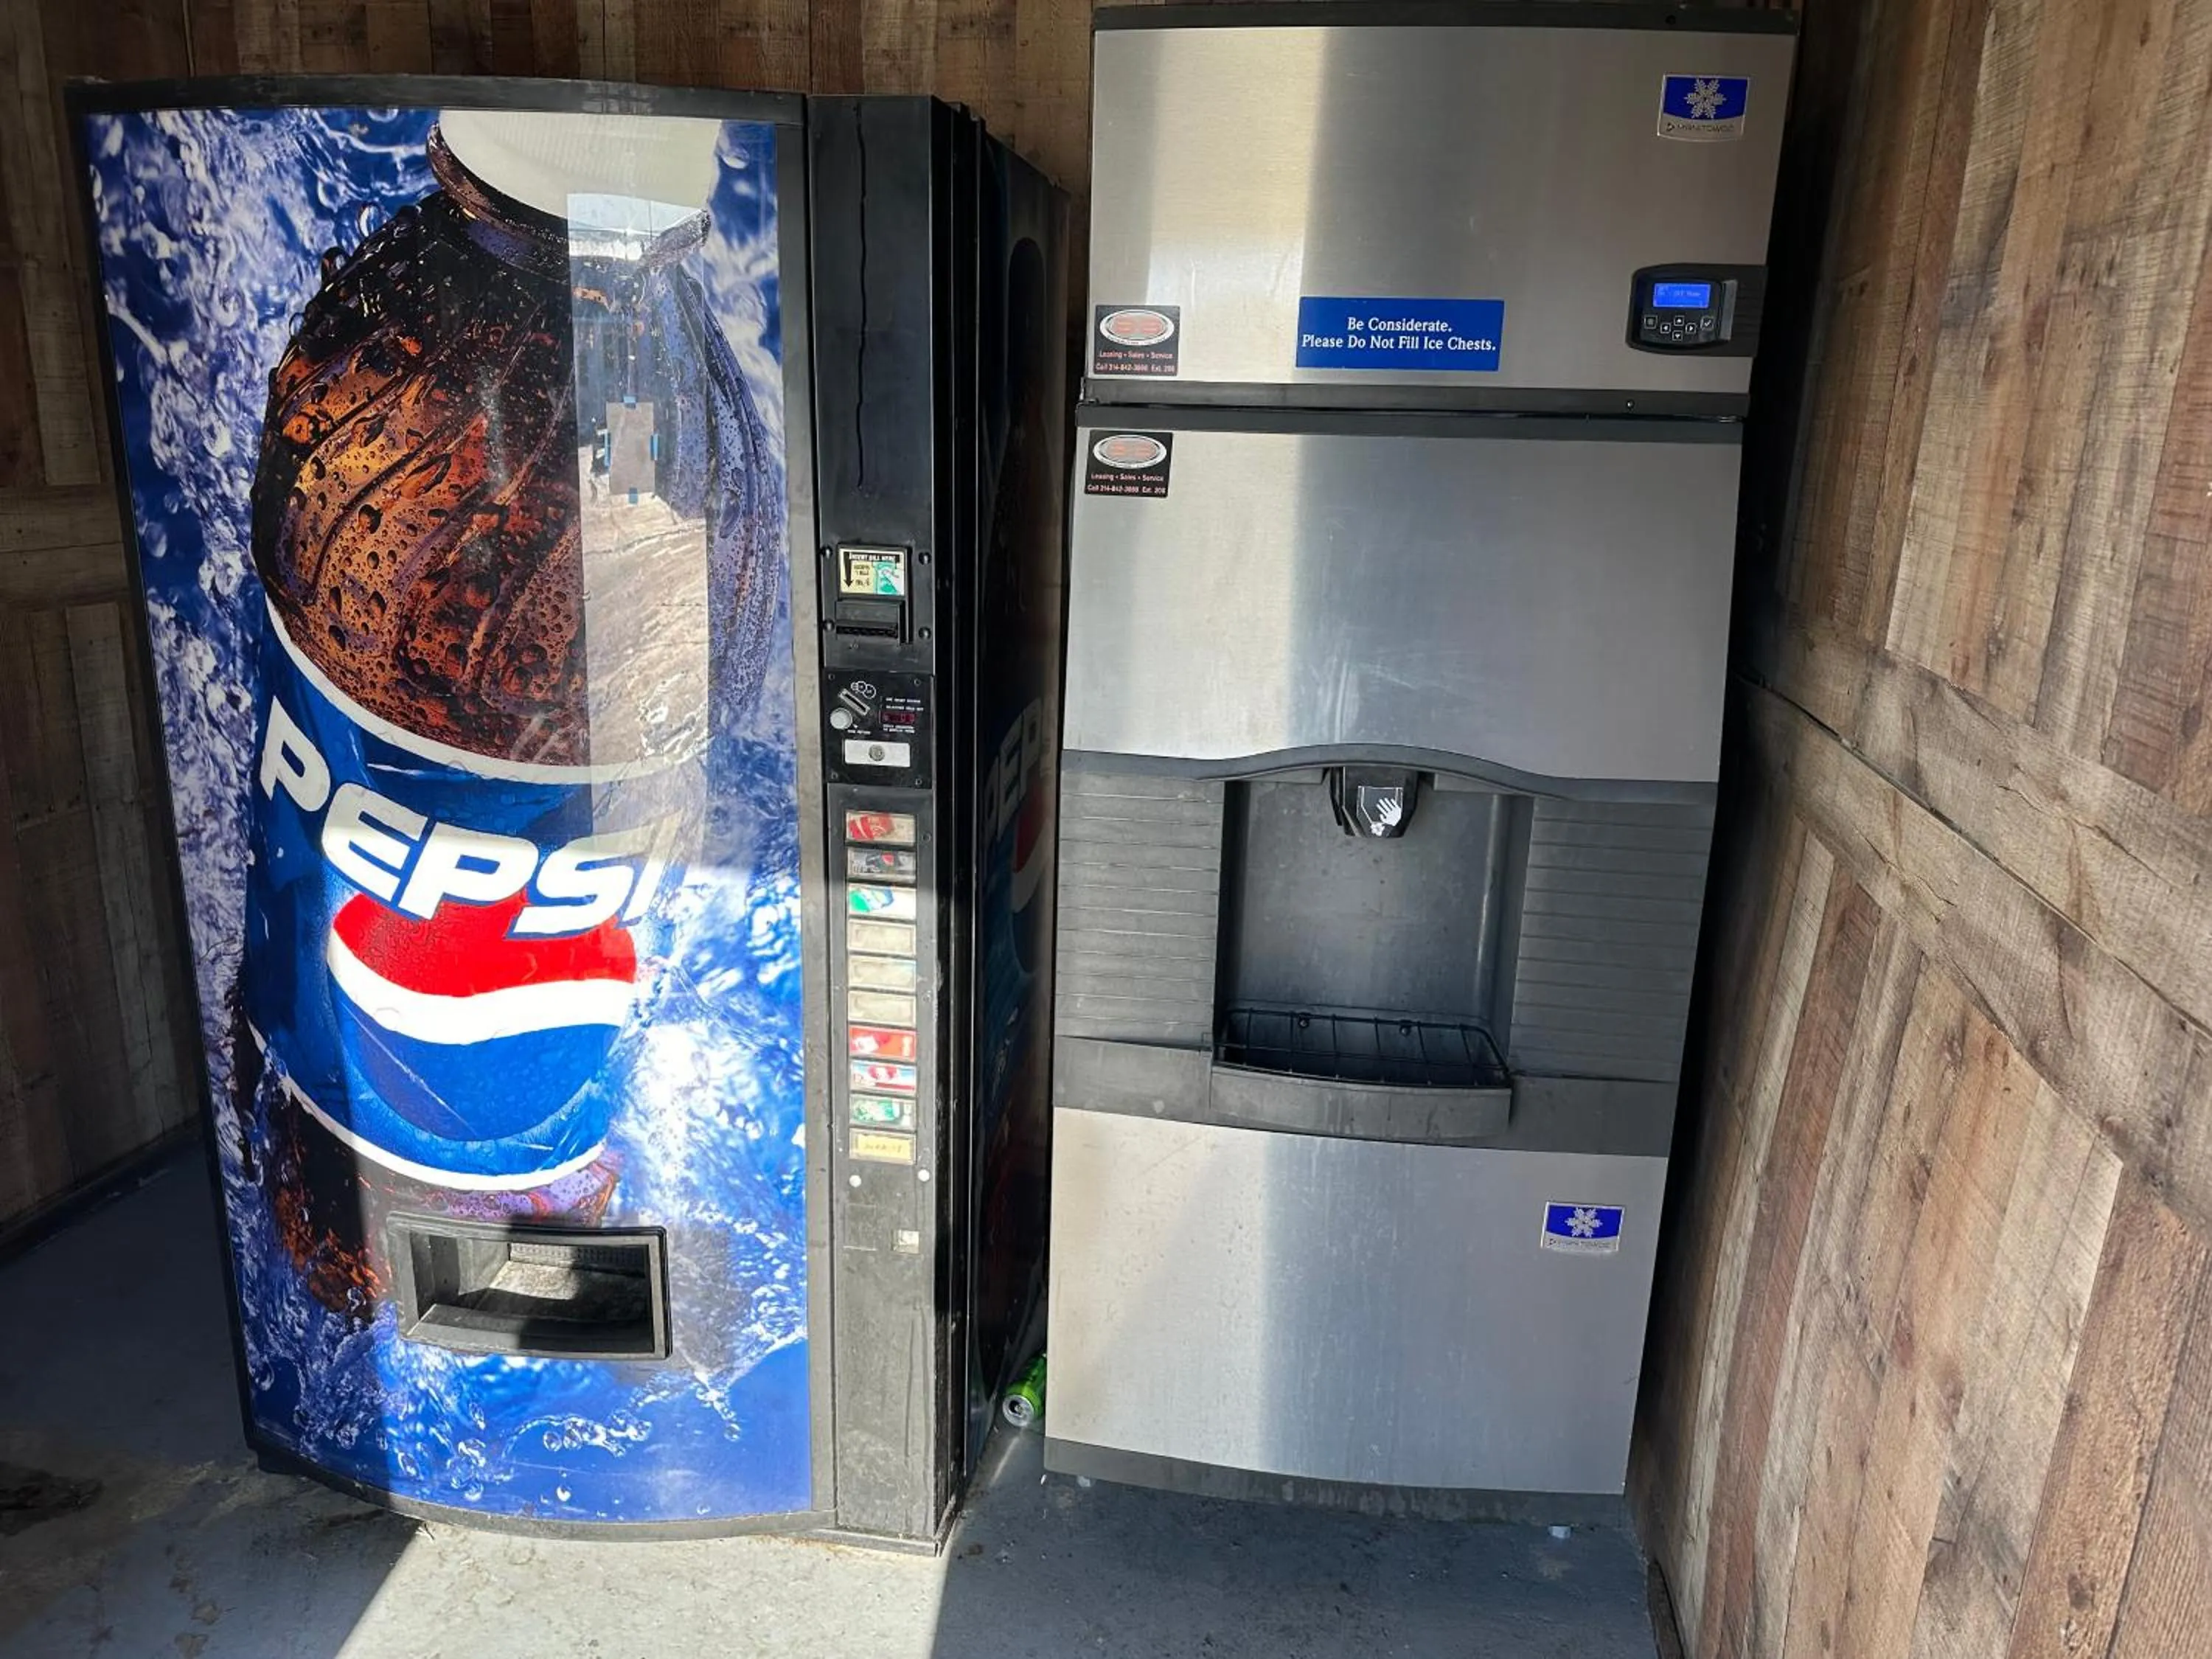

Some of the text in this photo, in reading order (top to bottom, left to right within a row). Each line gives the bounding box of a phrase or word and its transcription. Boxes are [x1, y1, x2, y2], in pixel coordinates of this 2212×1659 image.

[1347, 316, 1453, 333] Be Considerate.
[1301, 334, 1497, 351] Please Do Not Fill Ice Chests.
[1099, 350, 1174, 360] Leasing Sales Service
[1091, 473, 1114, 481] Leasing
[1142, 473, 1164, 481] Service
